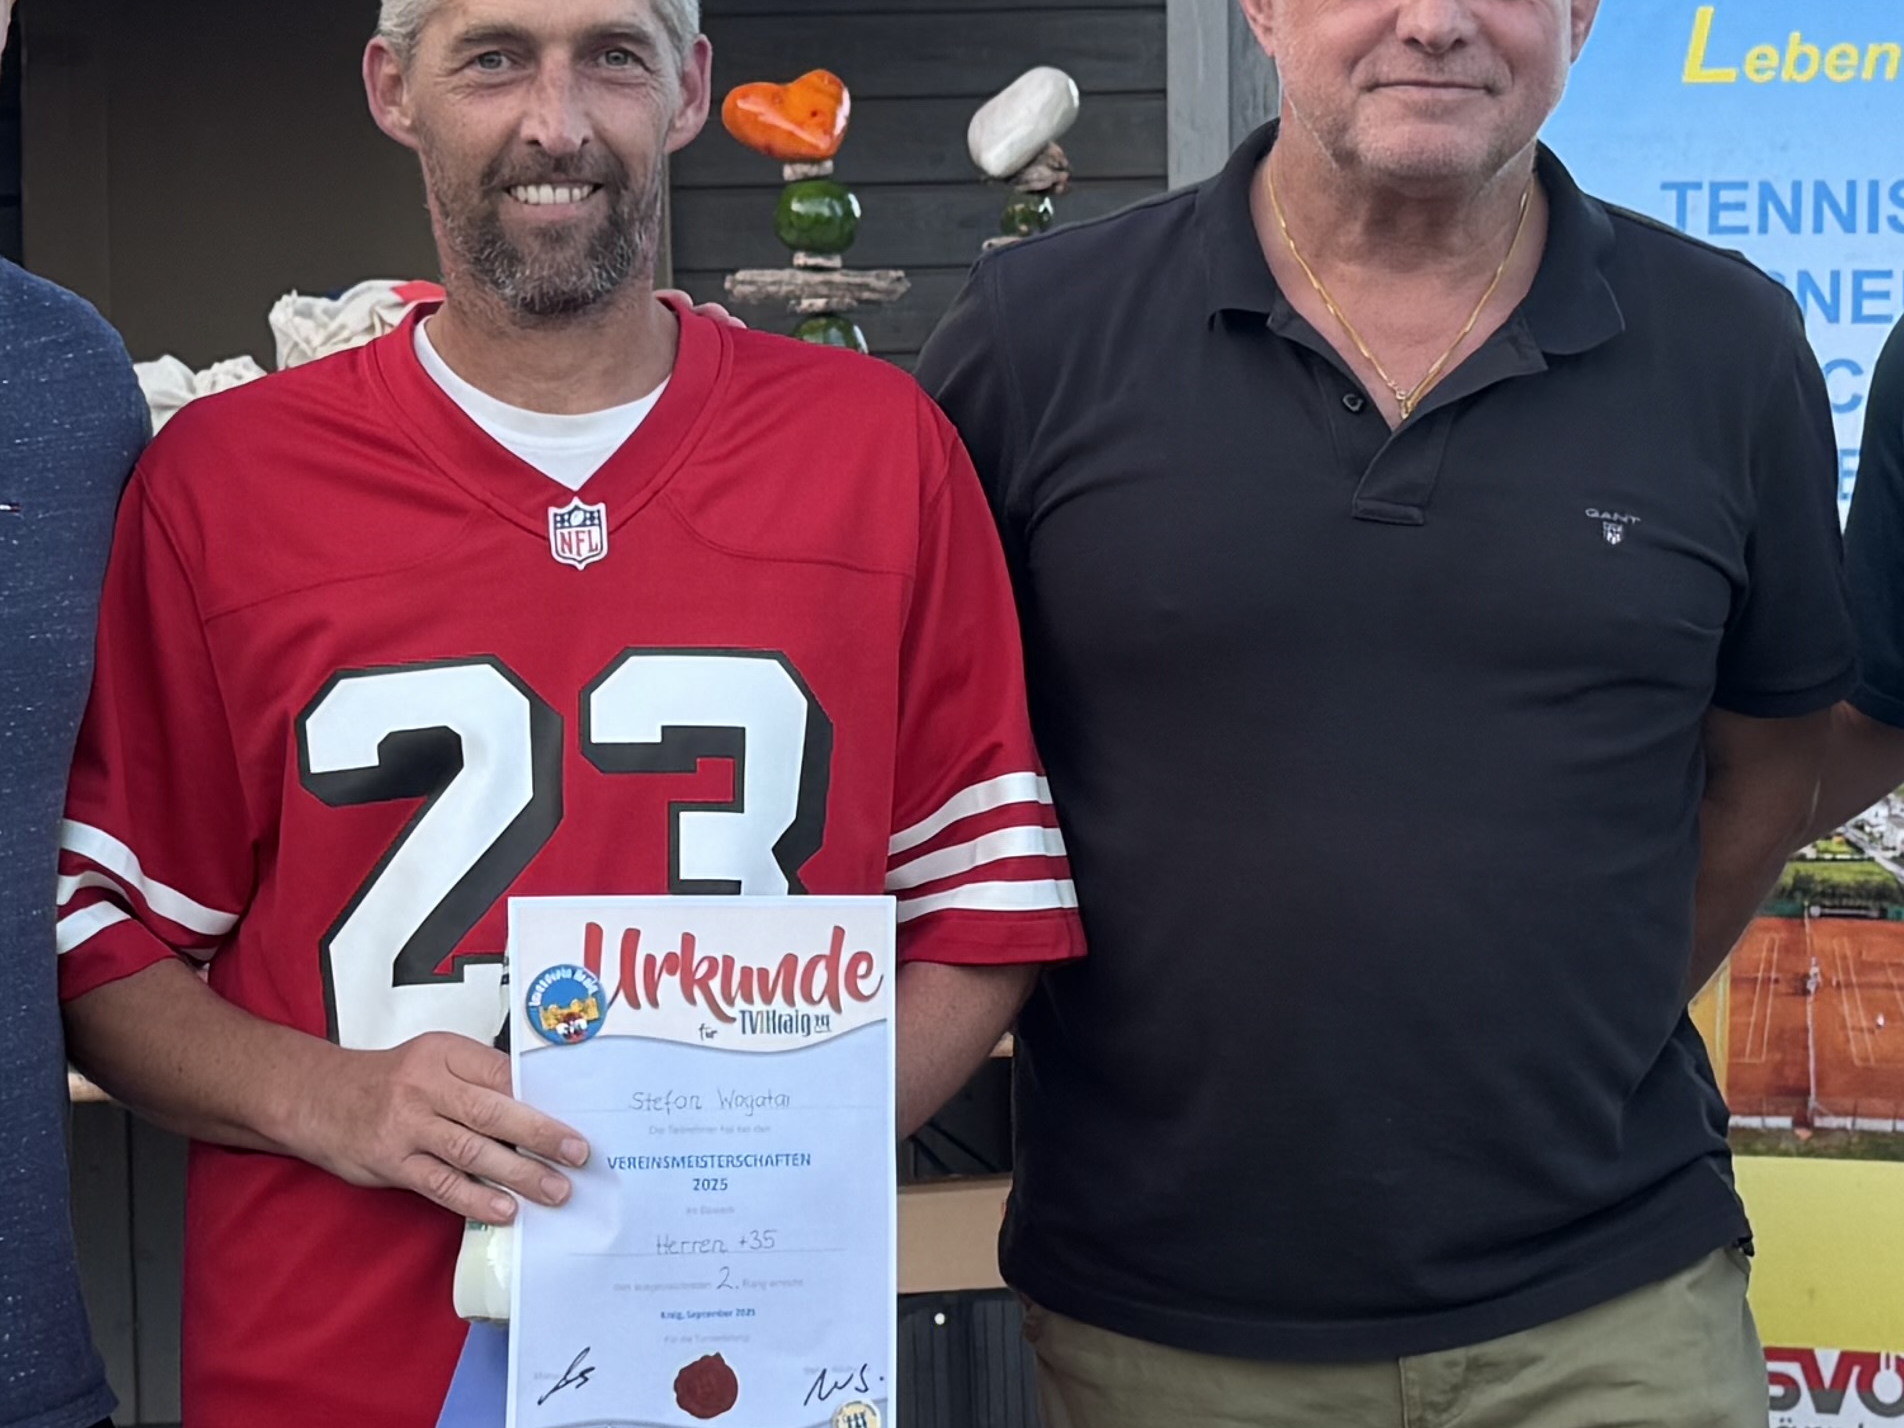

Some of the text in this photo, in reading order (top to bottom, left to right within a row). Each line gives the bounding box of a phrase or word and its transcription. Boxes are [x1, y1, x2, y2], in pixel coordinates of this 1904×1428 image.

[1682, 5, 1902, 84] Leben
[1585, 507, 1642, 524] GANT
[559, 529, 599, 557] NFL
[299, 647, 834, 1050] 23
[583, 922, 884, 1023] Urkunde
[607, 1153, 811, 1170] VEREINSMEISTERSCHAFTEN
[692, 1178, 729, 1191] 2025
[656, 1229, 778, 1256] Herren +35
